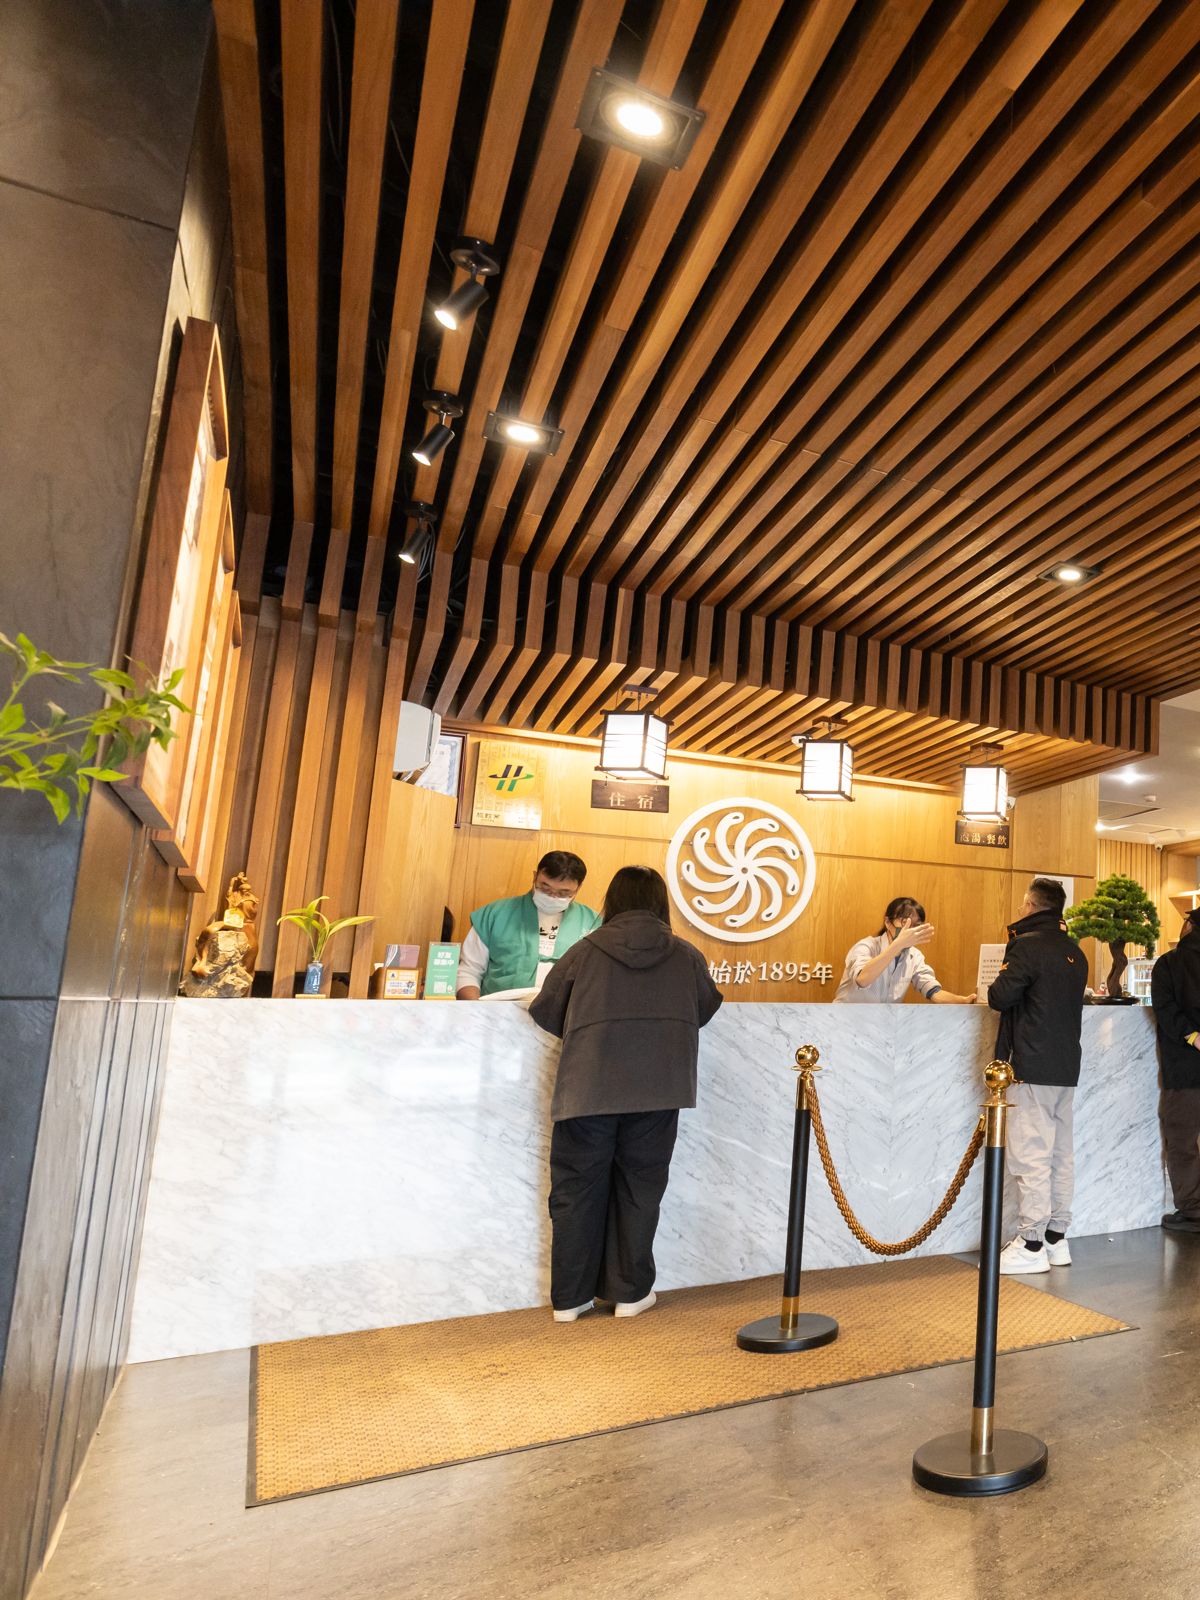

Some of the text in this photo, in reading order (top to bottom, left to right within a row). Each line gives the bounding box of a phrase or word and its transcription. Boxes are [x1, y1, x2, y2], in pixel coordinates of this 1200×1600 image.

[609, 792, 654, 809] 住宿
[708, 960, 834, 985] 始於1895年
